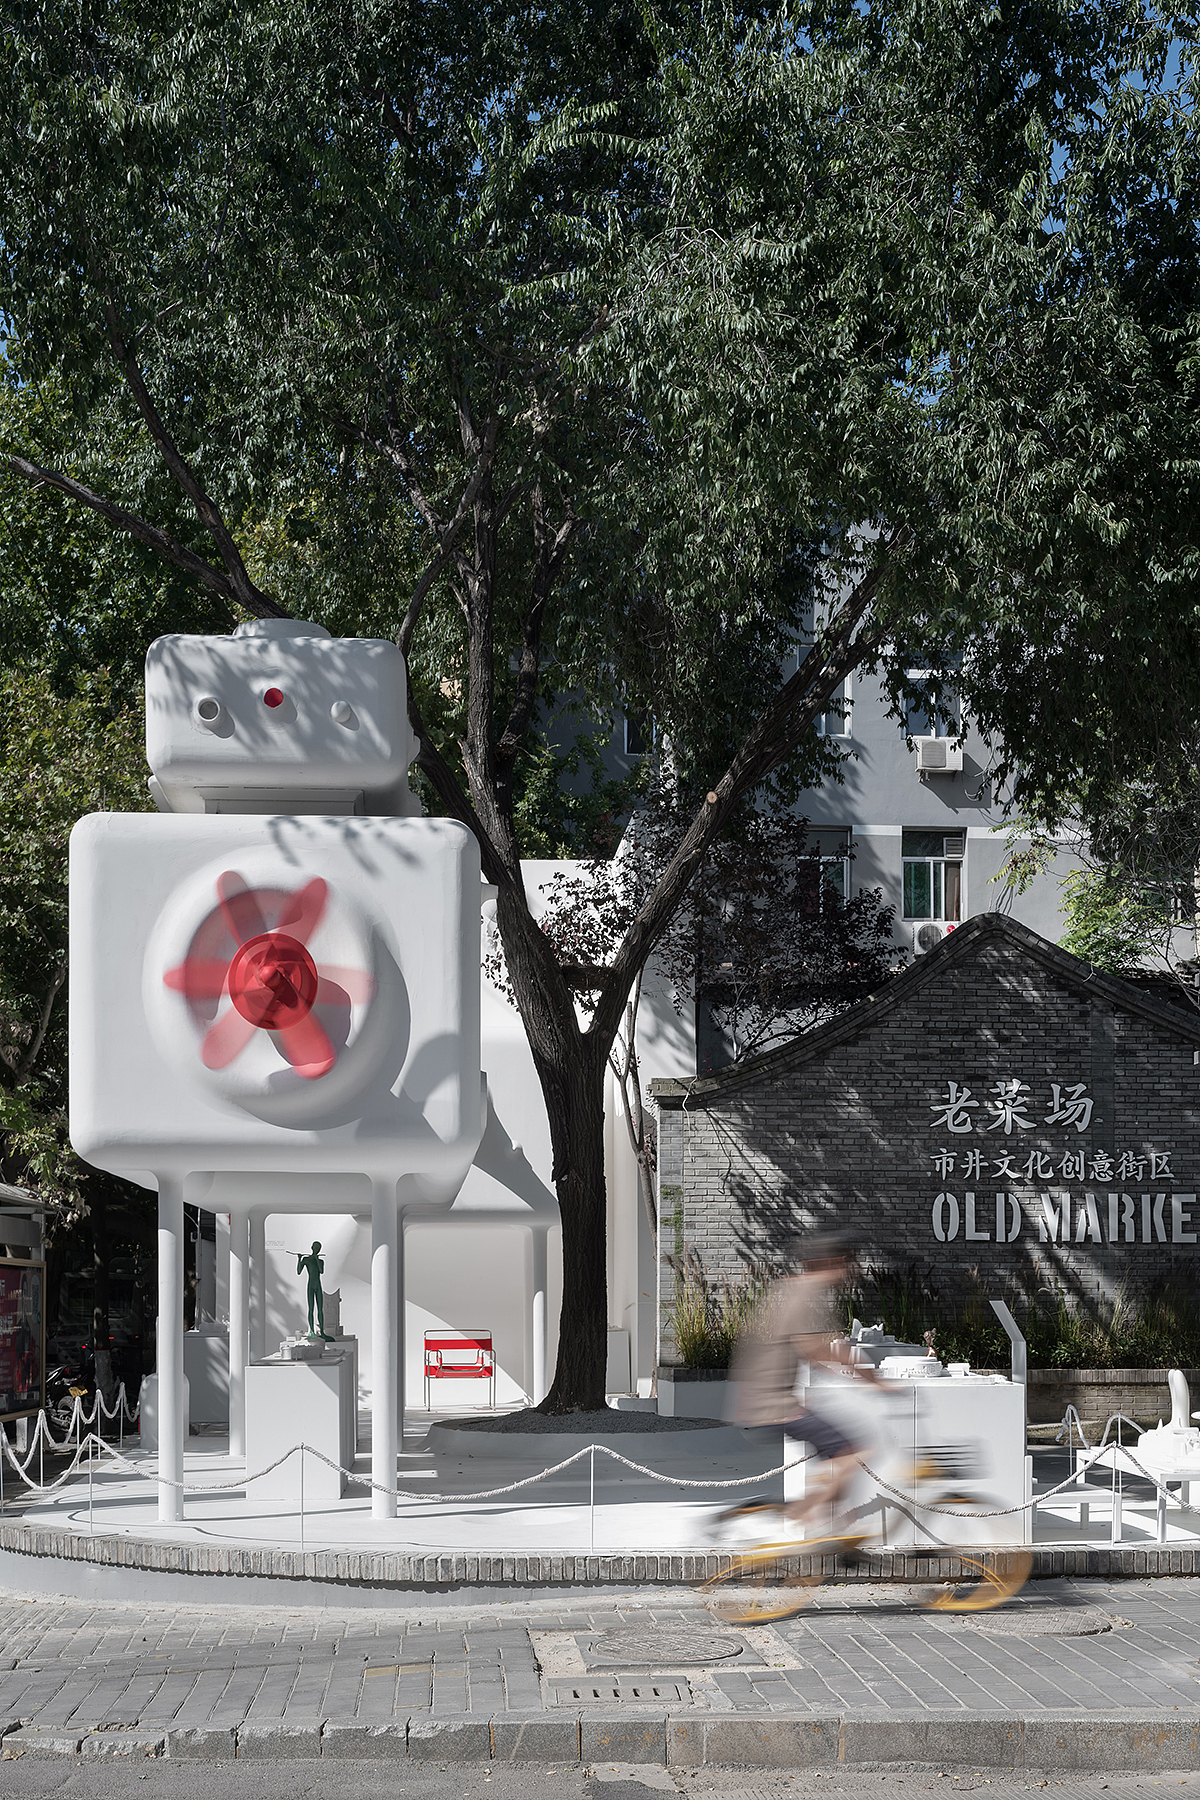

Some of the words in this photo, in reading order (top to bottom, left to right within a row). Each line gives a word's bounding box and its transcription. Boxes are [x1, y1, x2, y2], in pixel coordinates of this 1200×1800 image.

[930, 1079, 1094, 1135] 老菜场
[930, 1148, 1175, 1182] 市井文化创意街区
[932, 1192, 1022, 1243] OLD
[1039, 1193, 1197, 1243] MARKE
